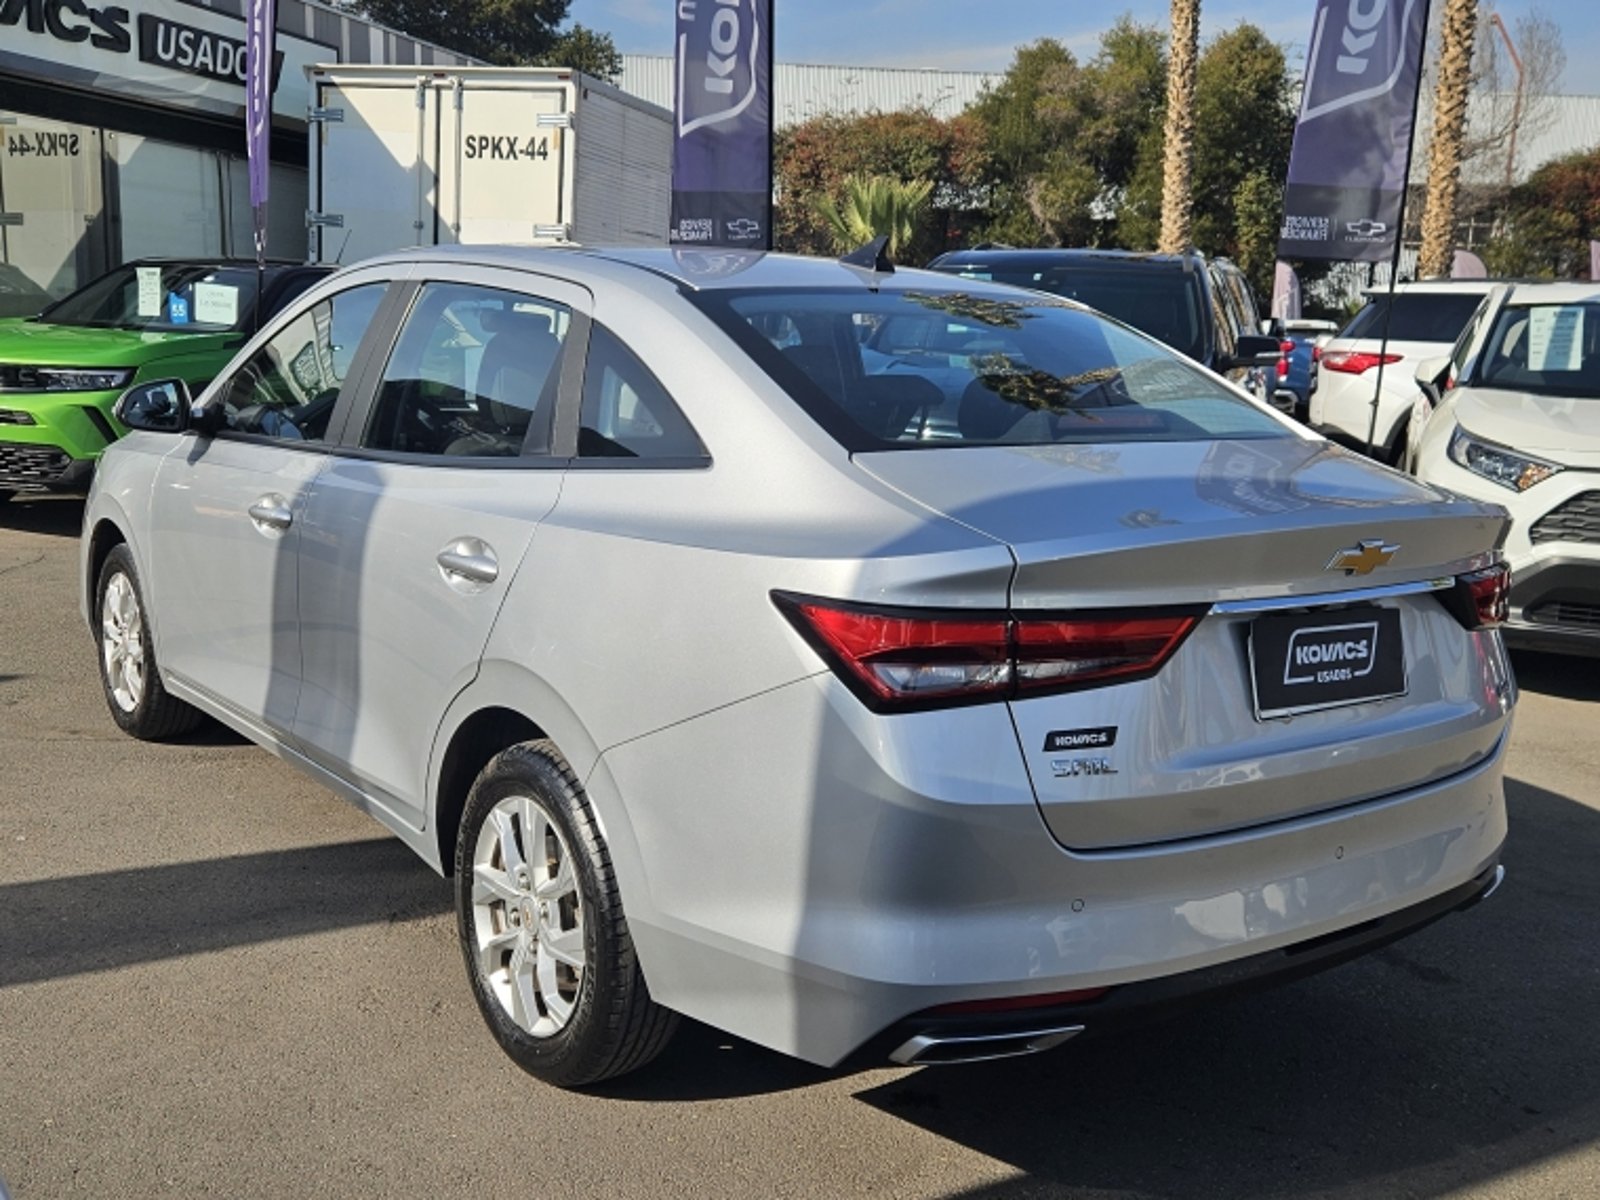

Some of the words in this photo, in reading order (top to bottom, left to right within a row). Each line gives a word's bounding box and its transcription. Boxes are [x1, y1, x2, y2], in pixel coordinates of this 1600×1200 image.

[157, 23, 247, 81] USADO
[465, 134, 548, 160] SPKX-44
[1296, 639, 1370, 665] KOVACS
[1317, 669, 1352, 683] USADOS
